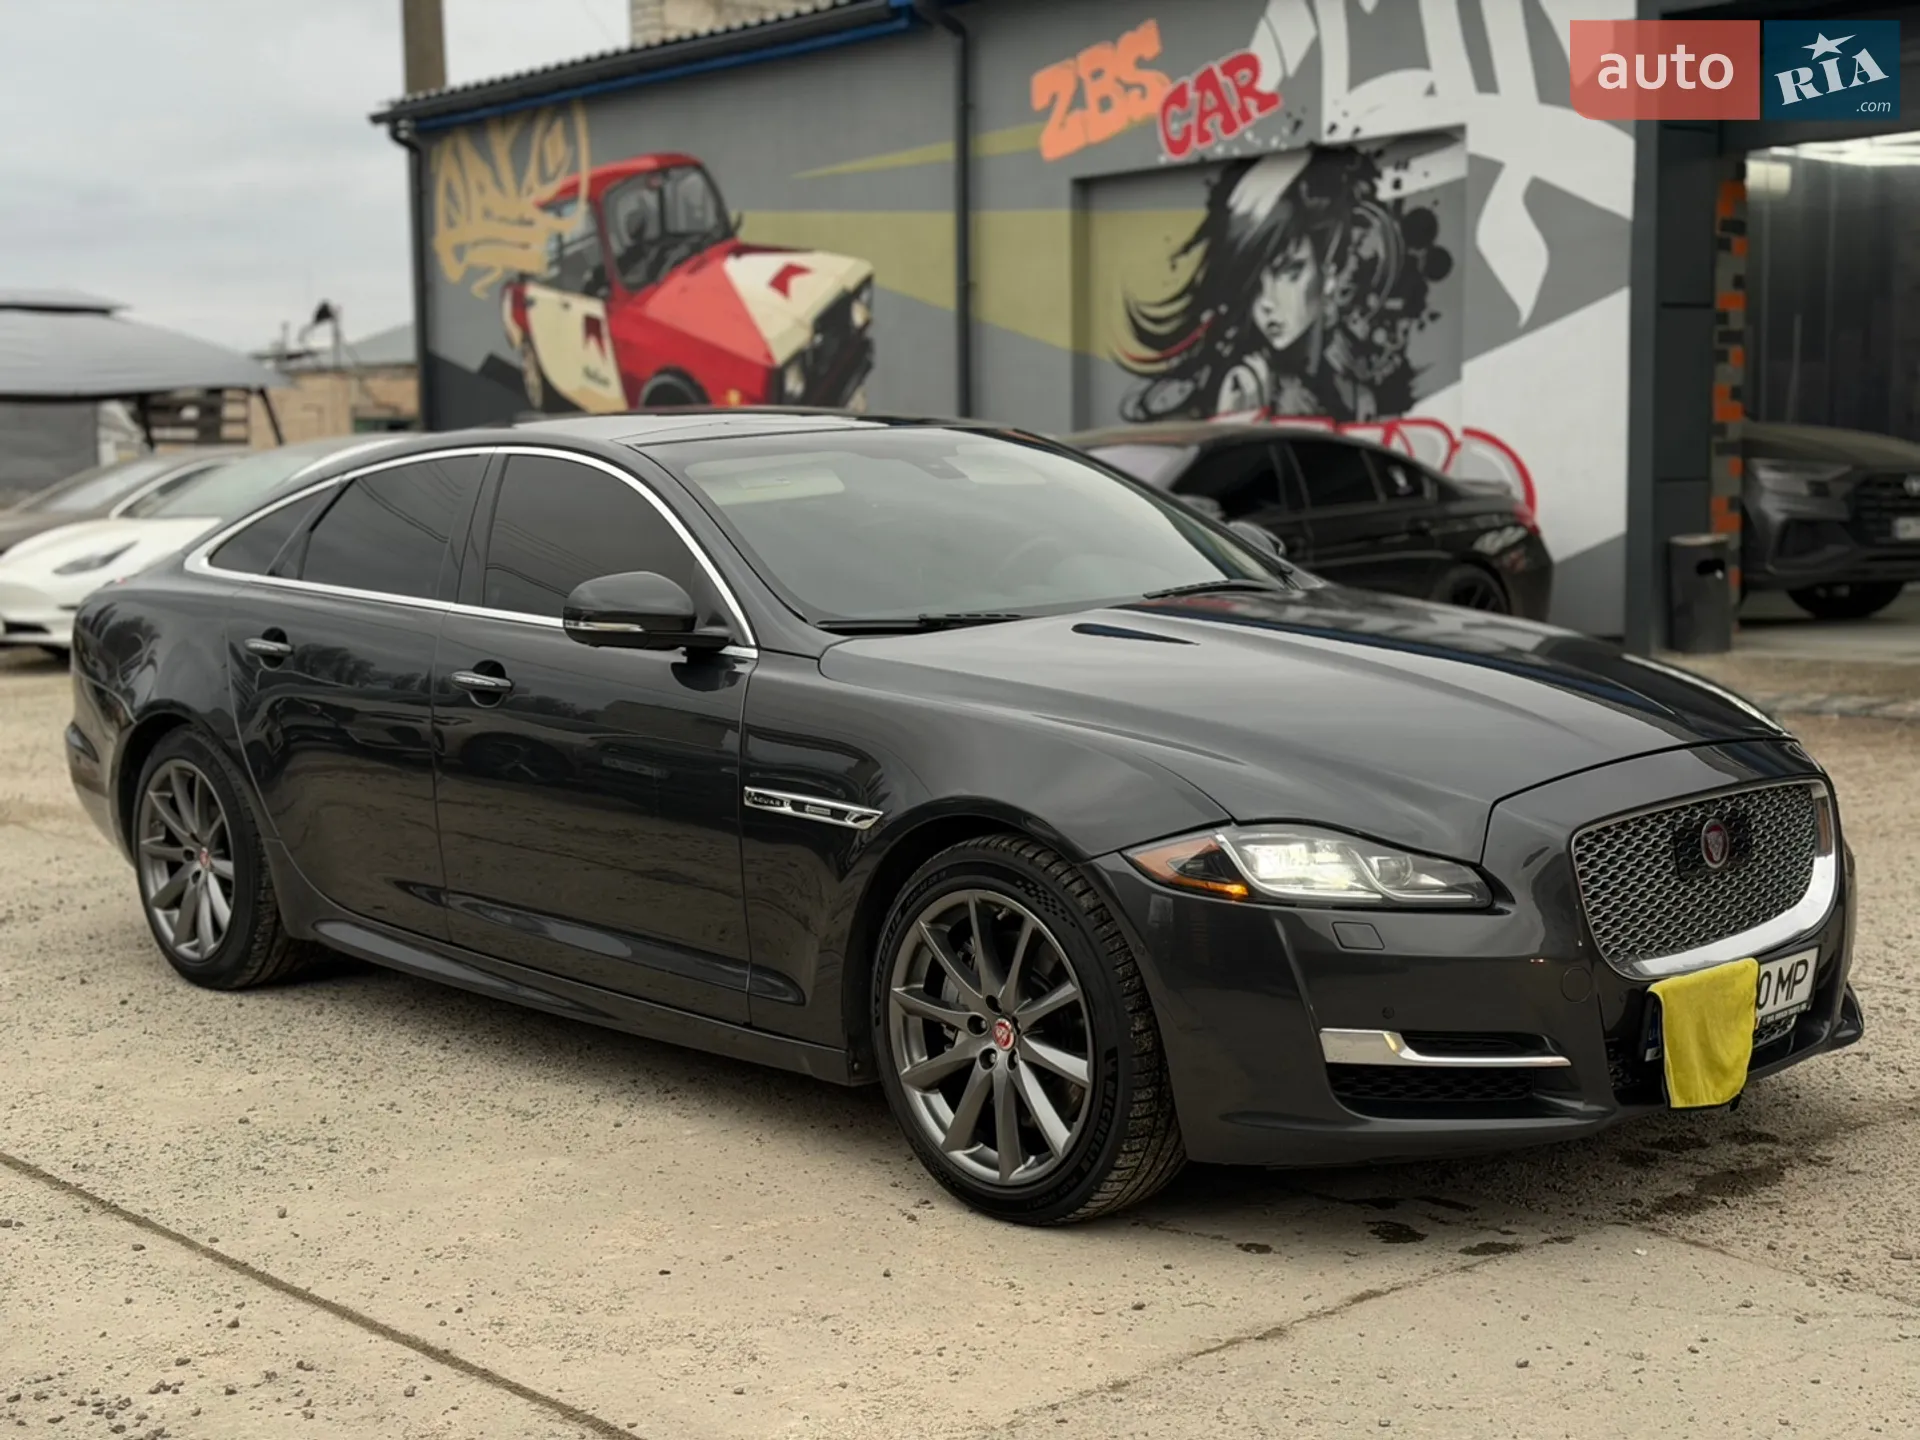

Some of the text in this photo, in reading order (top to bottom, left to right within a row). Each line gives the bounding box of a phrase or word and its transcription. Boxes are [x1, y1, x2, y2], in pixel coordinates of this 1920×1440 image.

[1030, 18, 1284, 162] ZBS CAR
[1774, 959, 1808, 1006] MP
